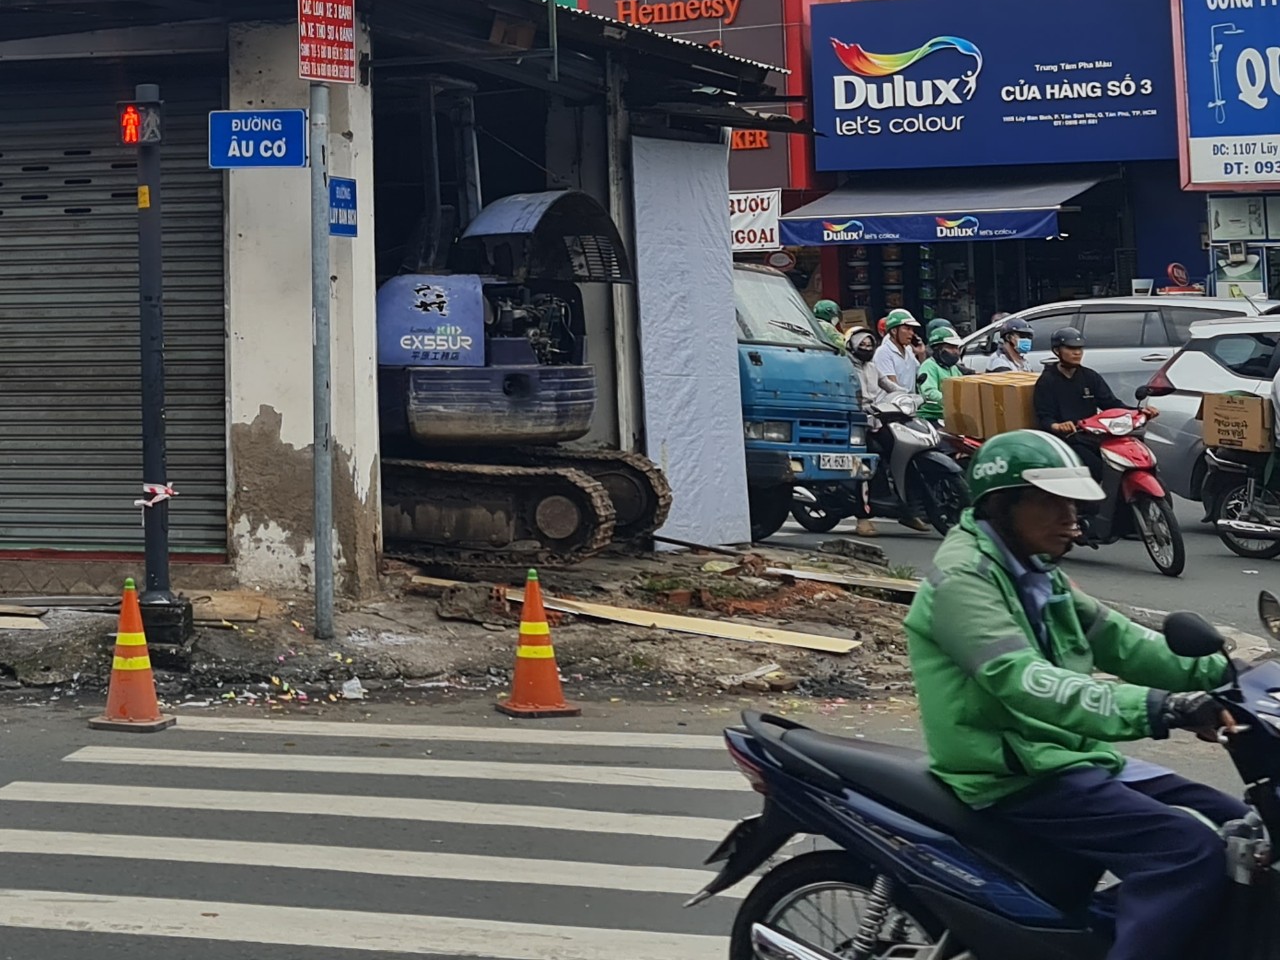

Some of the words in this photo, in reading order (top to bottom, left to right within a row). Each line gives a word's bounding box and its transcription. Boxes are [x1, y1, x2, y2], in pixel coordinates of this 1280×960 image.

[1034, 63, 1058, 72] Trung
[1060, 62, 1077, 71] Tâm
[1078, 61, 1094, 69] Pha
[833, 74, 963, 110] Dulux
[1001, 79, 1041, 101] CỬA
[1045, 79, 1102, 99] HÀNG
[1107, 74, 1136, 96] SỐ
[1140, 79, 1152, 94] 3
[231, 116, 282, 132] ĐƯỜNG
[835, 114, 881, 135] let's
[888, 113, 965, 133] colour
[227, 136, 255, 157] ÂU
[259, 137, 287, 158] CƠ
[1213, 143, 1229, 156] ĐC:
[1233, 143, 1257, 155] 1107
[1260, 141, 1278, 156] Lũy
[1224, 162, 1249, 175] ĐT:
[823, 230, 859, 241] Dulux
[936, 226, 973, 237] Dulux
[972, 457, 1009, 480] Grab
[1022, 660, 1119, 717] Gra
